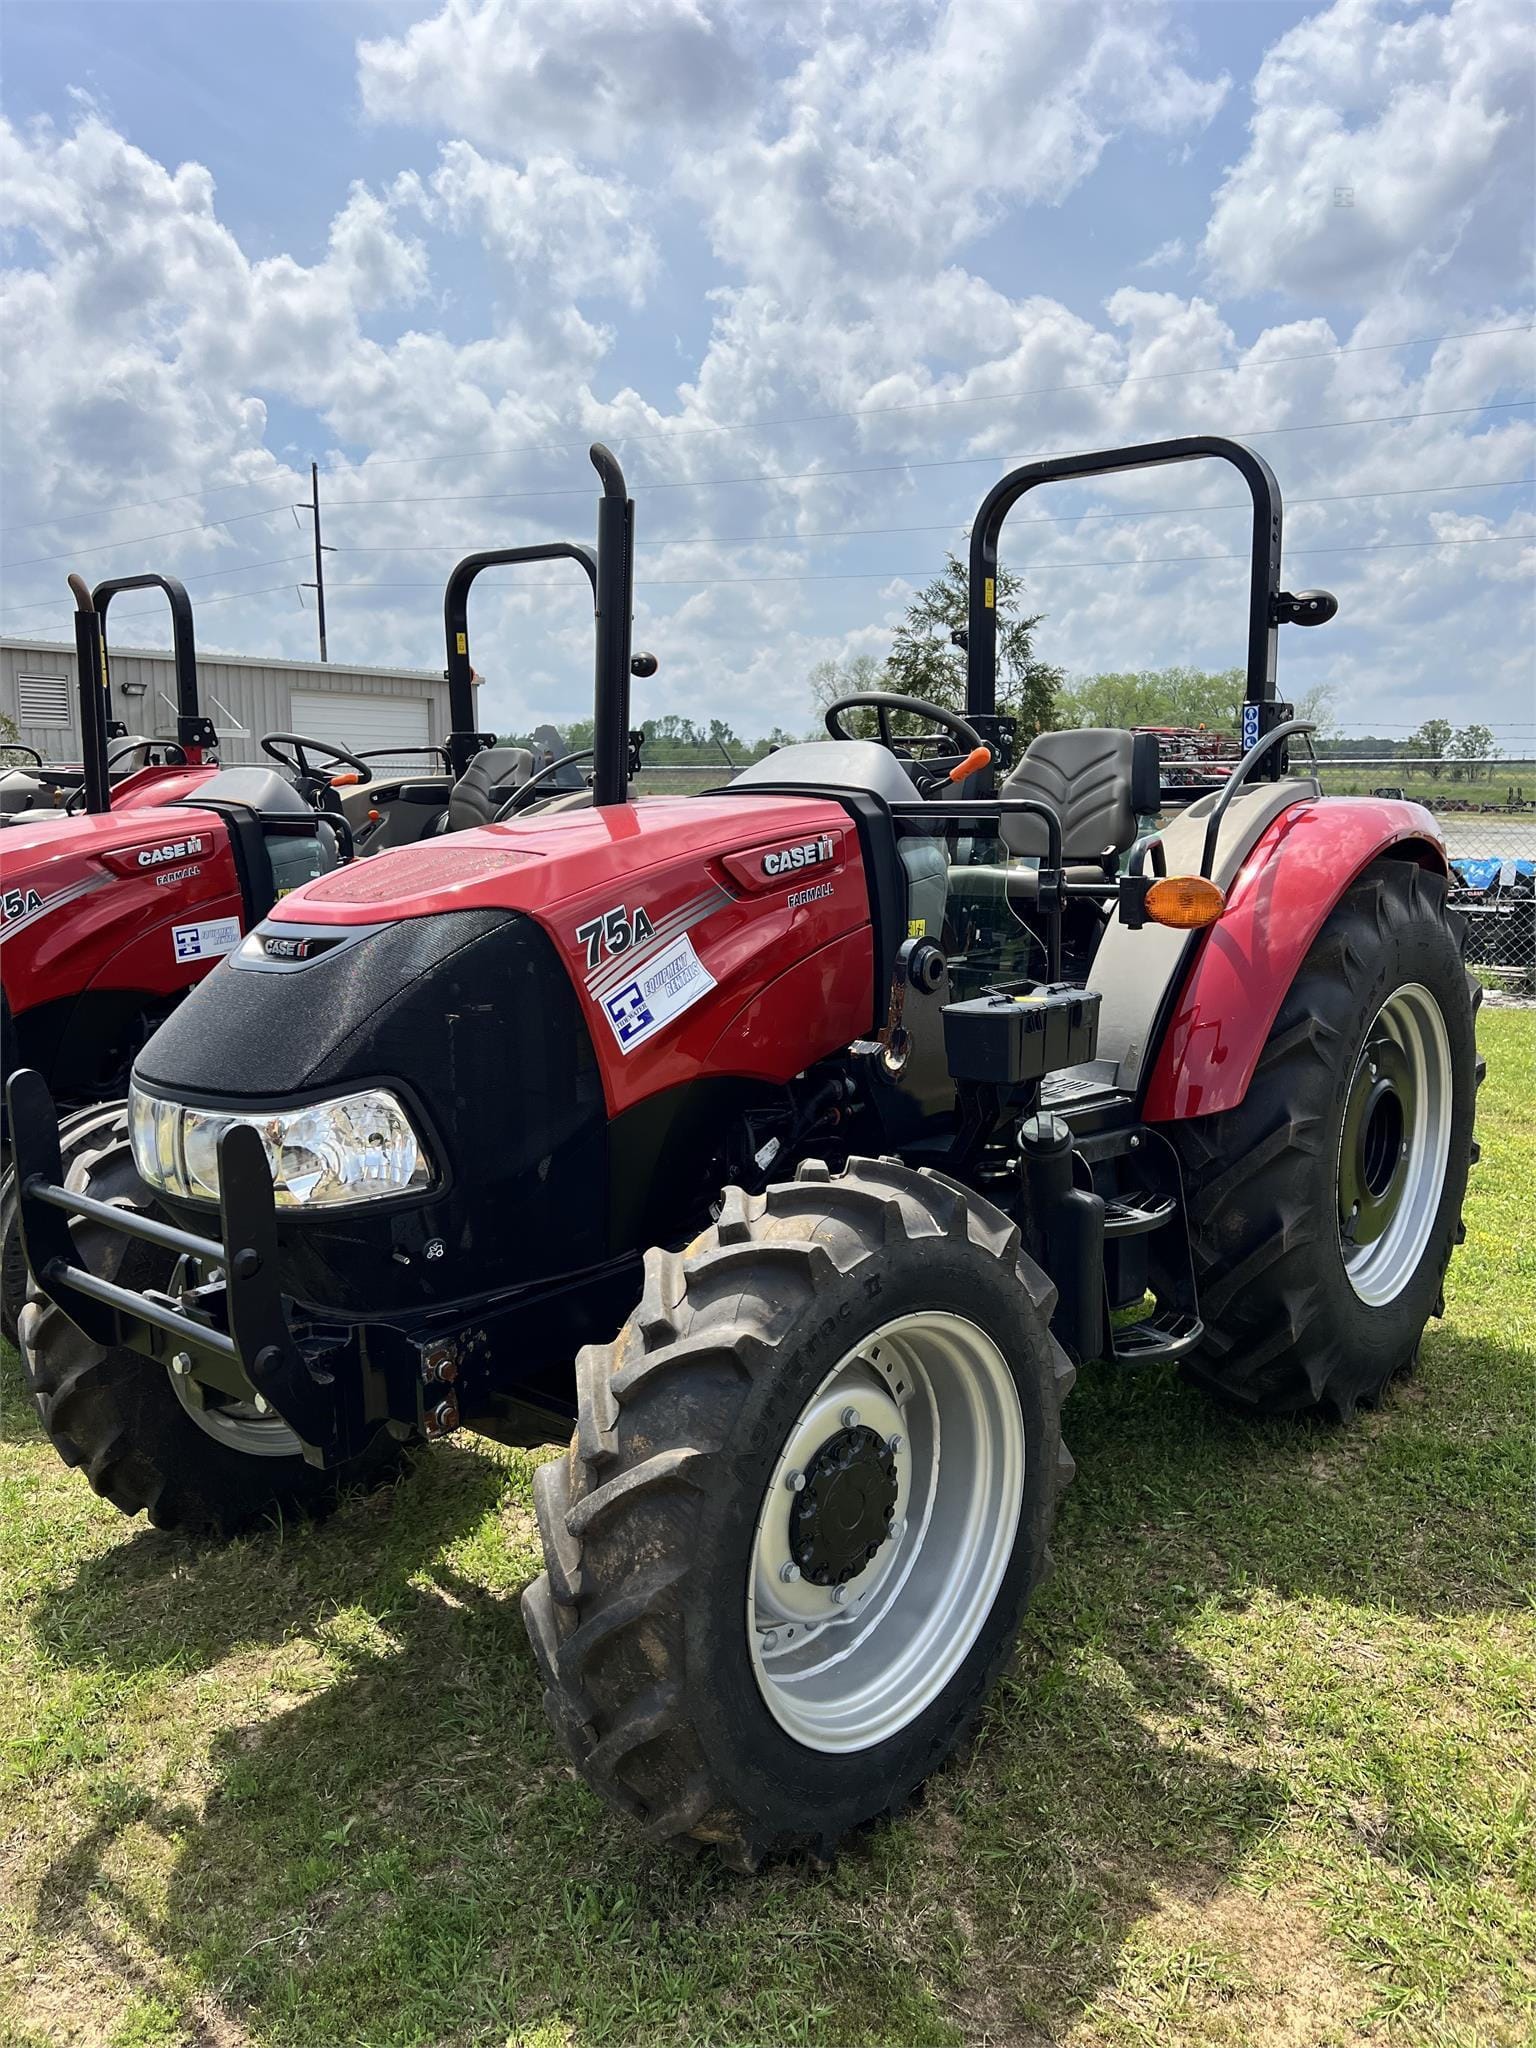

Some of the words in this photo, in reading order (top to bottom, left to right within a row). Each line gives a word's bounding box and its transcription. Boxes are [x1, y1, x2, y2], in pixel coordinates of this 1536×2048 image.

[138, 843, 186, 866] CASE
[765, 843, 817, 874] CASE
[156, 866, 200, 886] FARMALL
[0, 888, 45, 920] 5A
[787, 882, 834, 908] FARMALL
[265, 939, 296, 956] CASE
[575, 904, 657, 970] 75A
[643, 951, 689, 998] EQUIPMENT
[664, 961, 700, 998] RENTALS
